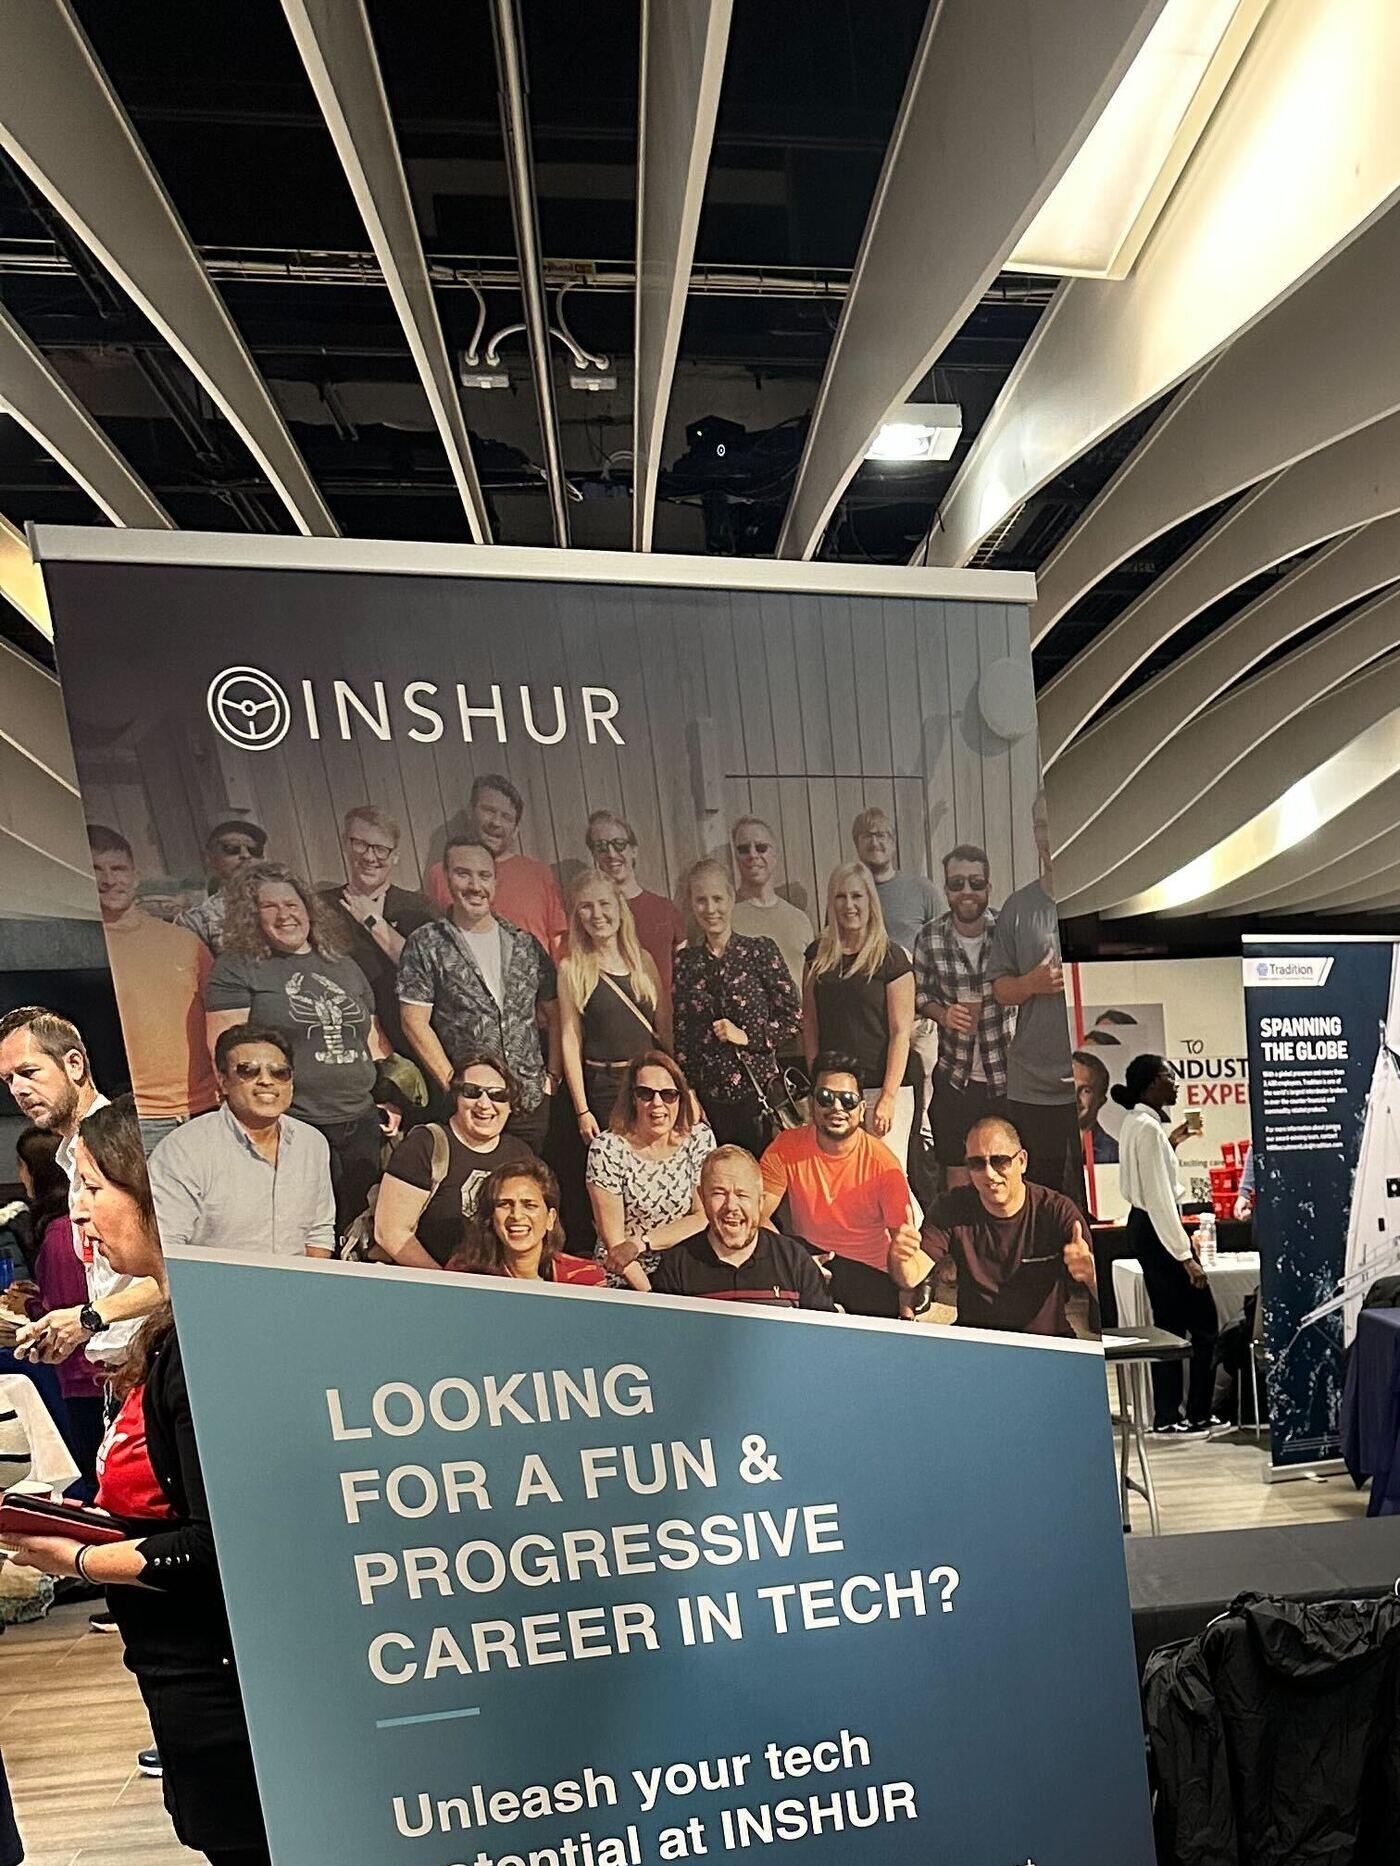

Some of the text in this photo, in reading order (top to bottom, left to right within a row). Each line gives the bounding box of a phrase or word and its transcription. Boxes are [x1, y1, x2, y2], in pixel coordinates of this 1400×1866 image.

[302, 680, 626, 745] INSHUR
[1269, 964, 1314, 975] Tradition
[1180, 1039, 1204, 1055] TO
[1260, 1016, 1342, 1038] SPANNING
[1260, 1040, 1349, 1062] THE GLOBE
[325, 1363, 654, 1441] LOOKING
[339, 1434, 783, 1524] FOR A FUN &
[353, 1503, 844, 1605] PROGRESSIVE
[368, 1566, 959, 1685] CAREER IN TECH?
[392, 1729, 871, 1838] Unleash your tech
[658, 1817, 708, 1860] at
[720, 1781, 918, 1850] INSHUR
